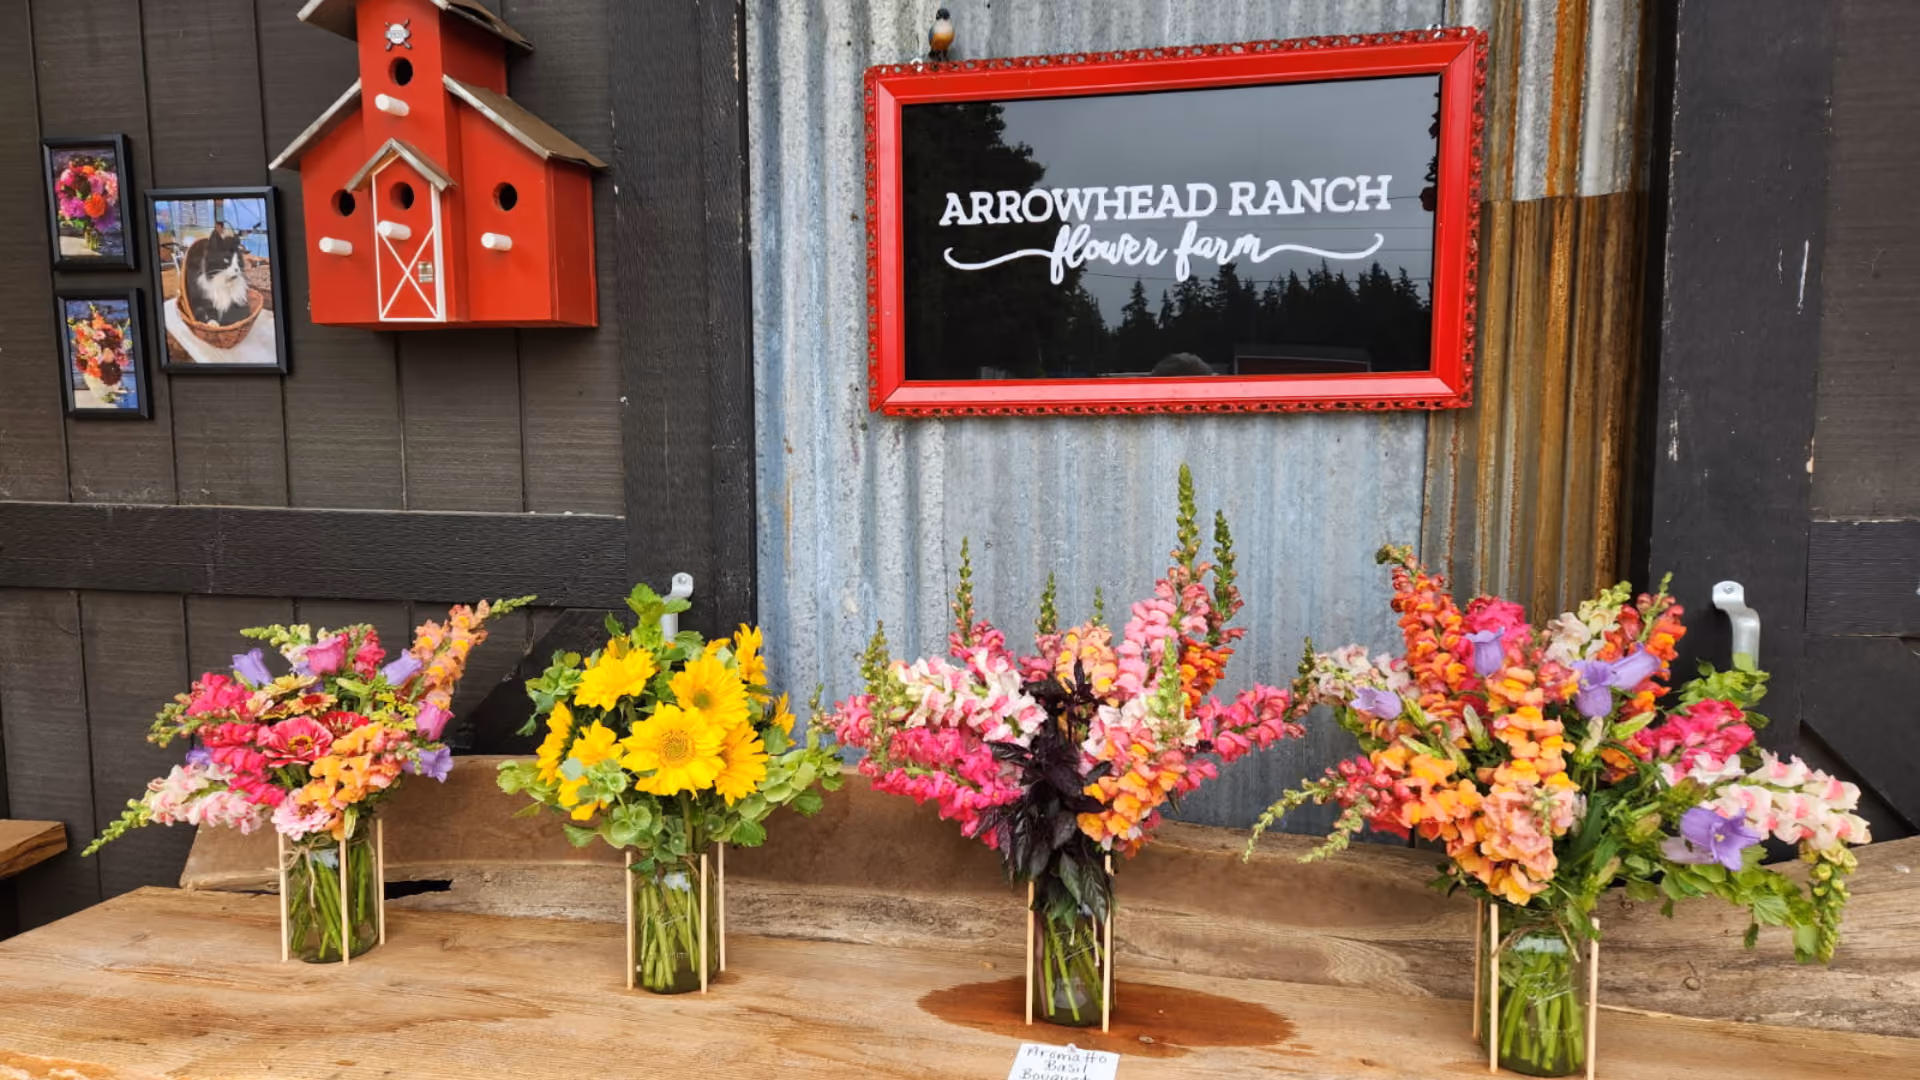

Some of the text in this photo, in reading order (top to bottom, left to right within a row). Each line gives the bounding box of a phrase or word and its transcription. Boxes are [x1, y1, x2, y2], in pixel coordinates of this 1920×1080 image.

[939, 175, 1392, 225] ARROWHEAD RANCH
[1049, 220, 1271, 285] flower farm
[1045, 1059, 1087, 1073] Basil
